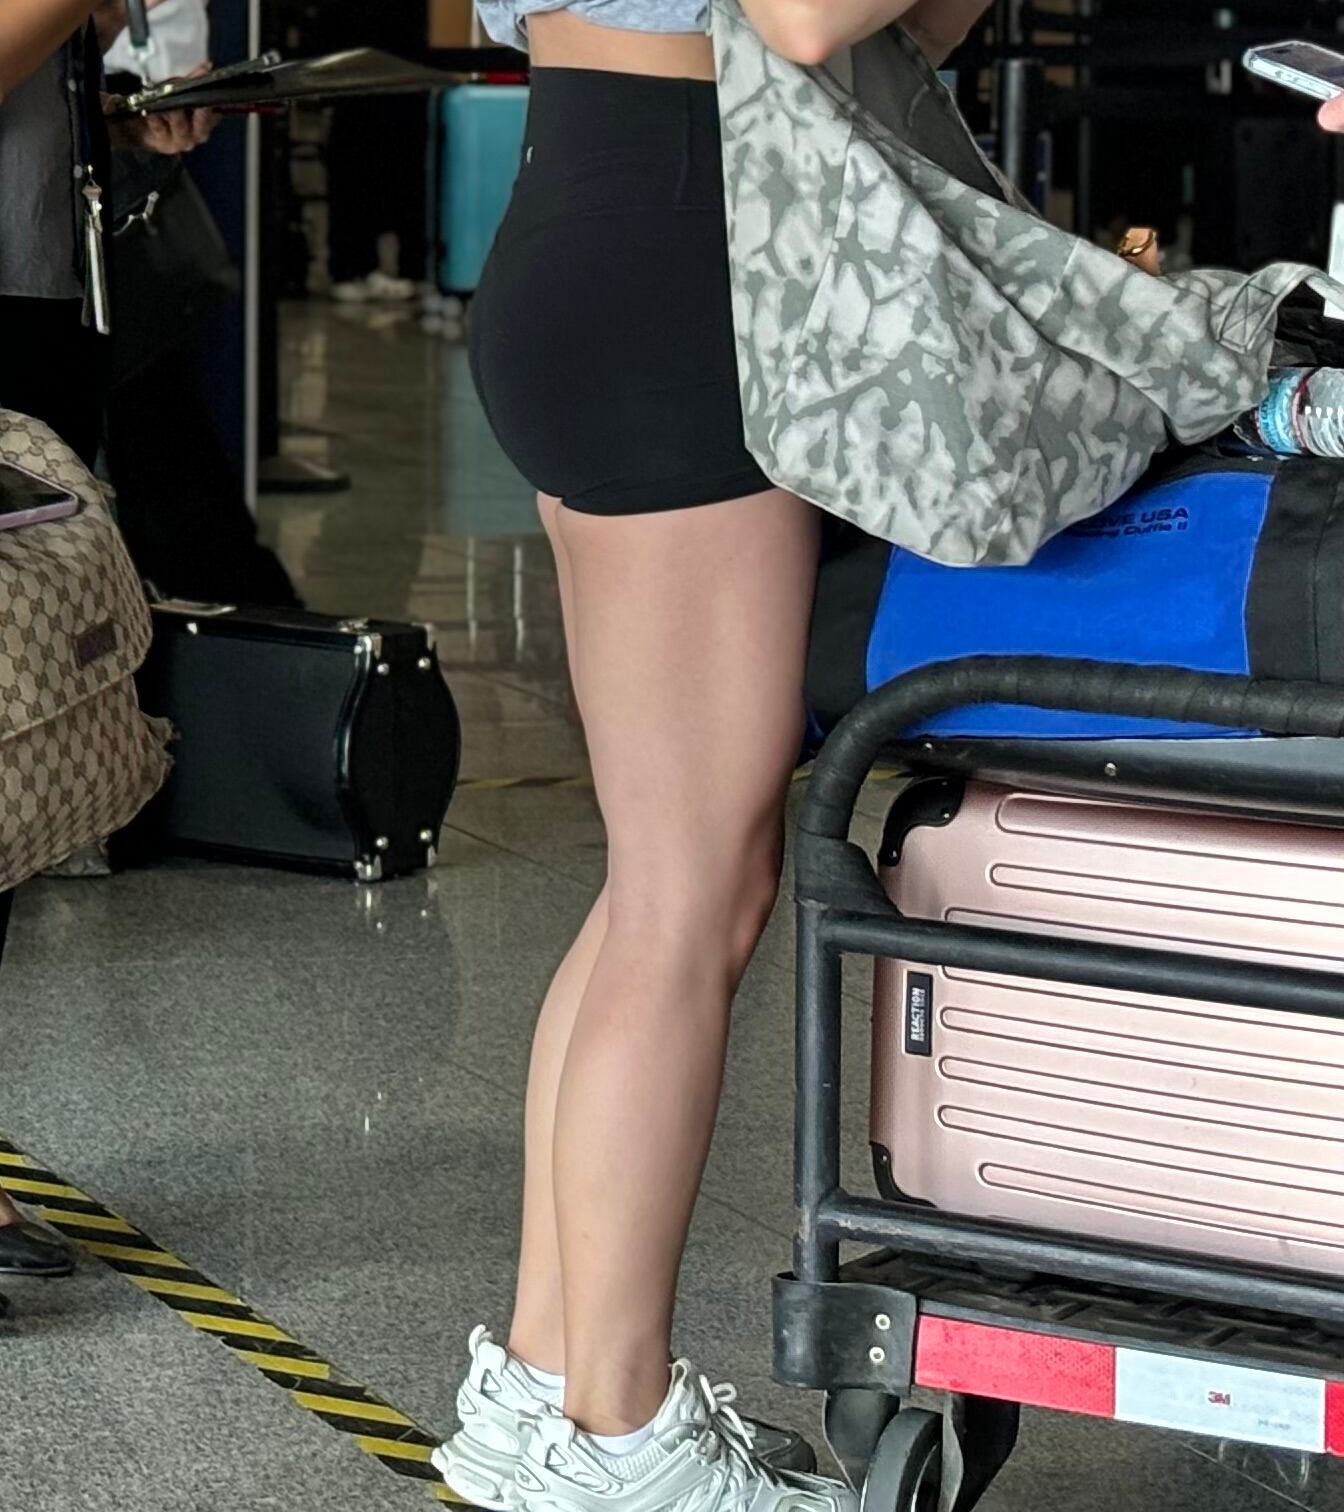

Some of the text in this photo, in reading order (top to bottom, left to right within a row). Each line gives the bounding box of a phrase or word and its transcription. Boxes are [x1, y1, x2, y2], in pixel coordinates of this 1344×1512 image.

[1140, 507, 1190, 524] USA
[910, 987, 921, 1042] REACTION
[1207, 1390, 1231, 1406] 3M
